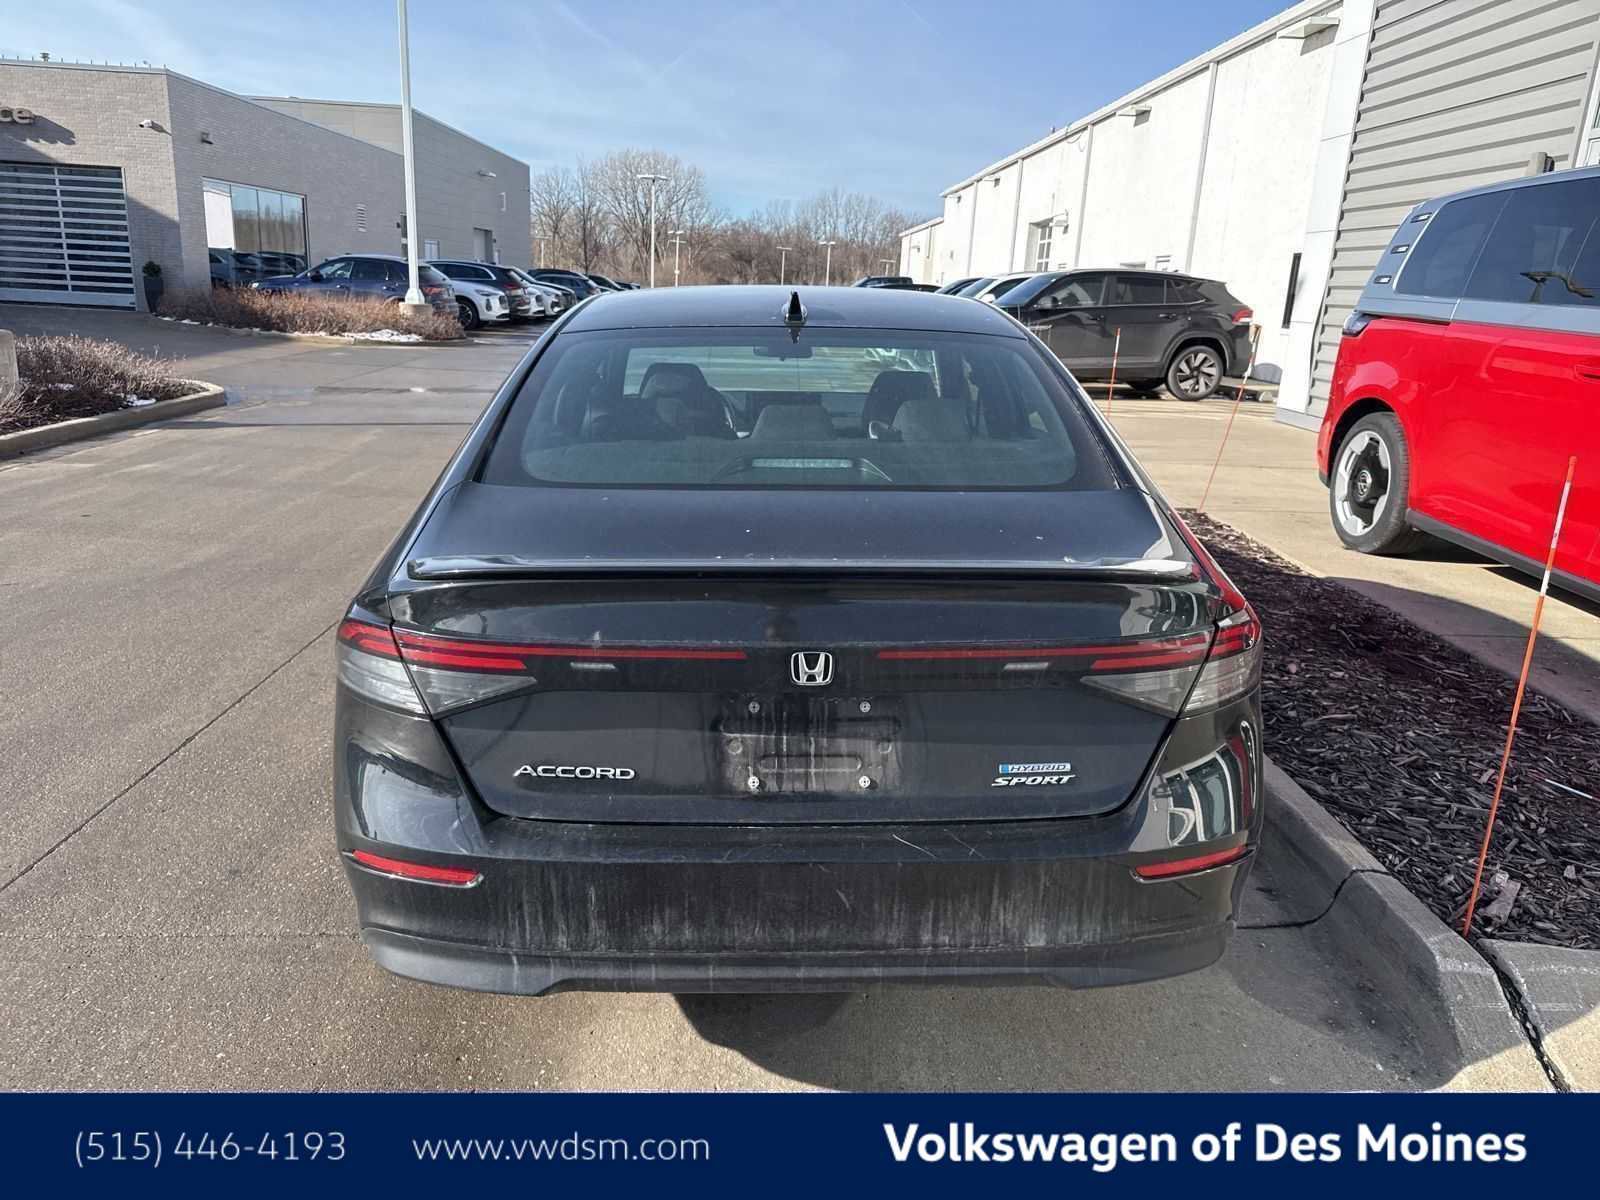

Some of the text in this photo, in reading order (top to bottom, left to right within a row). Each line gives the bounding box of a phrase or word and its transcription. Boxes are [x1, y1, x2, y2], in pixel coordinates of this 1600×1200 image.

[512, 765, 636, 780] ACCORD
[1008, 763, 1069, 773] HYBRID
[991, 774, 1076, 787] SPORT
